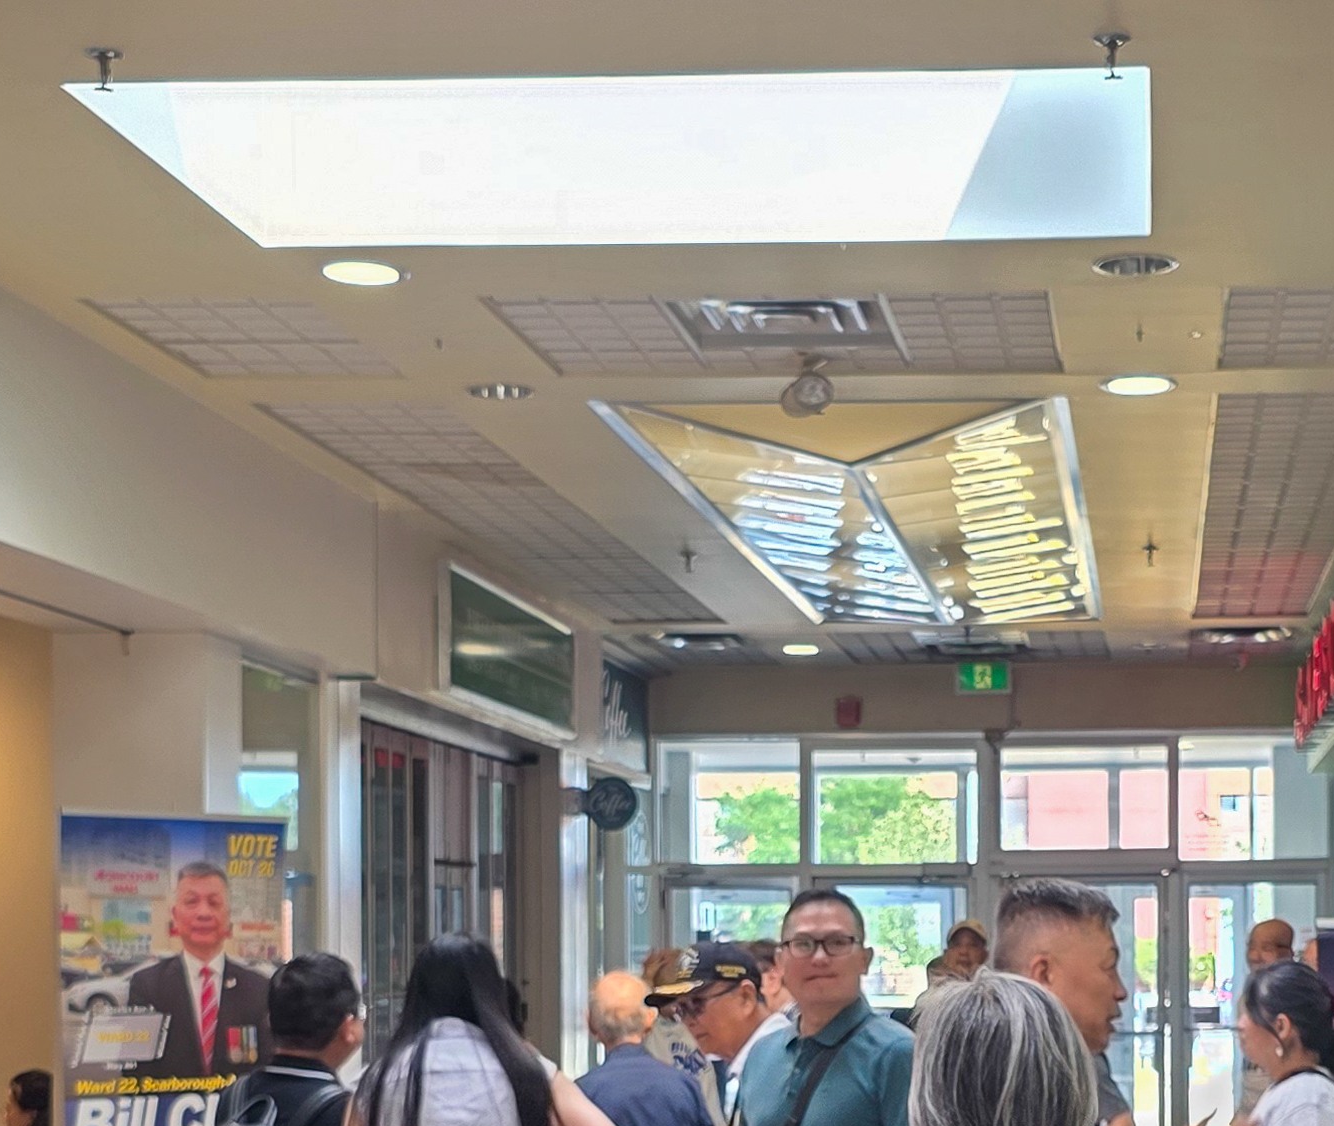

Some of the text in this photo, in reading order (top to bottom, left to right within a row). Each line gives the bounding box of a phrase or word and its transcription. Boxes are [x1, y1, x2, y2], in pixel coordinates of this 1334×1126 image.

[228, 833, 279, 858] VOTE
[75, 1079, 115, 1095] Ward
[117, 1076, 141, 1095] 22,
